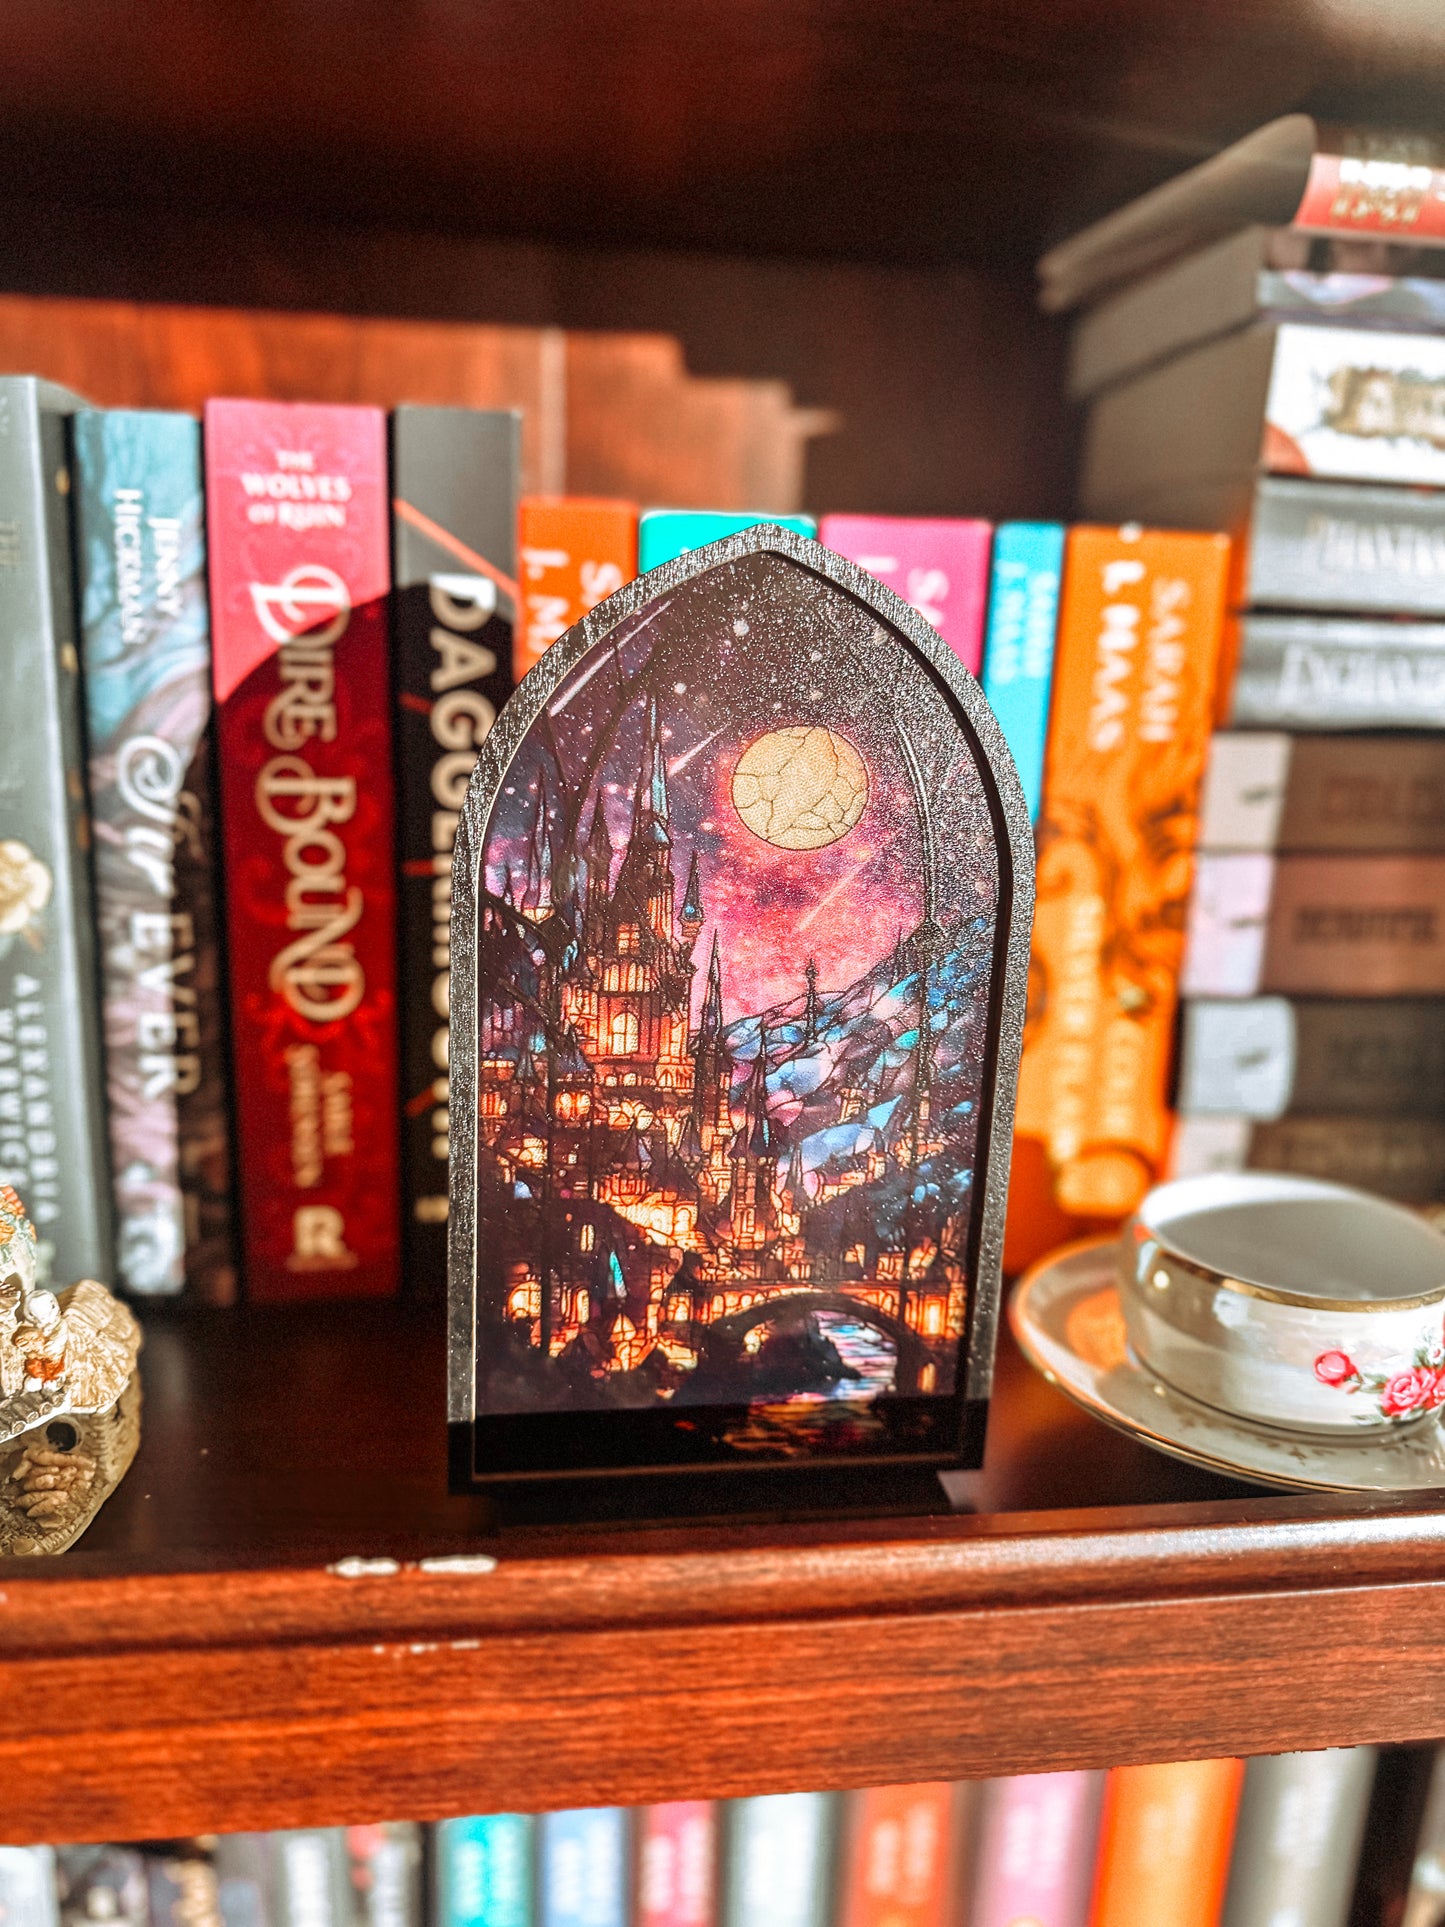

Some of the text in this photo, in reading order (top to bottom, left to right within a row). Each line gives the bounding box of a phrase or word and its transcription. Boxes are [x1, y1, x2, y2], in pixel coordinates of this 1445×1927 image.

[241, 472, 352, 502] WOLVES
[249, 564, 352, 750] DIRE
[130, 911, 201, 1098] EVER
[13, 973, 60, 1225] ALEXANDRIA
